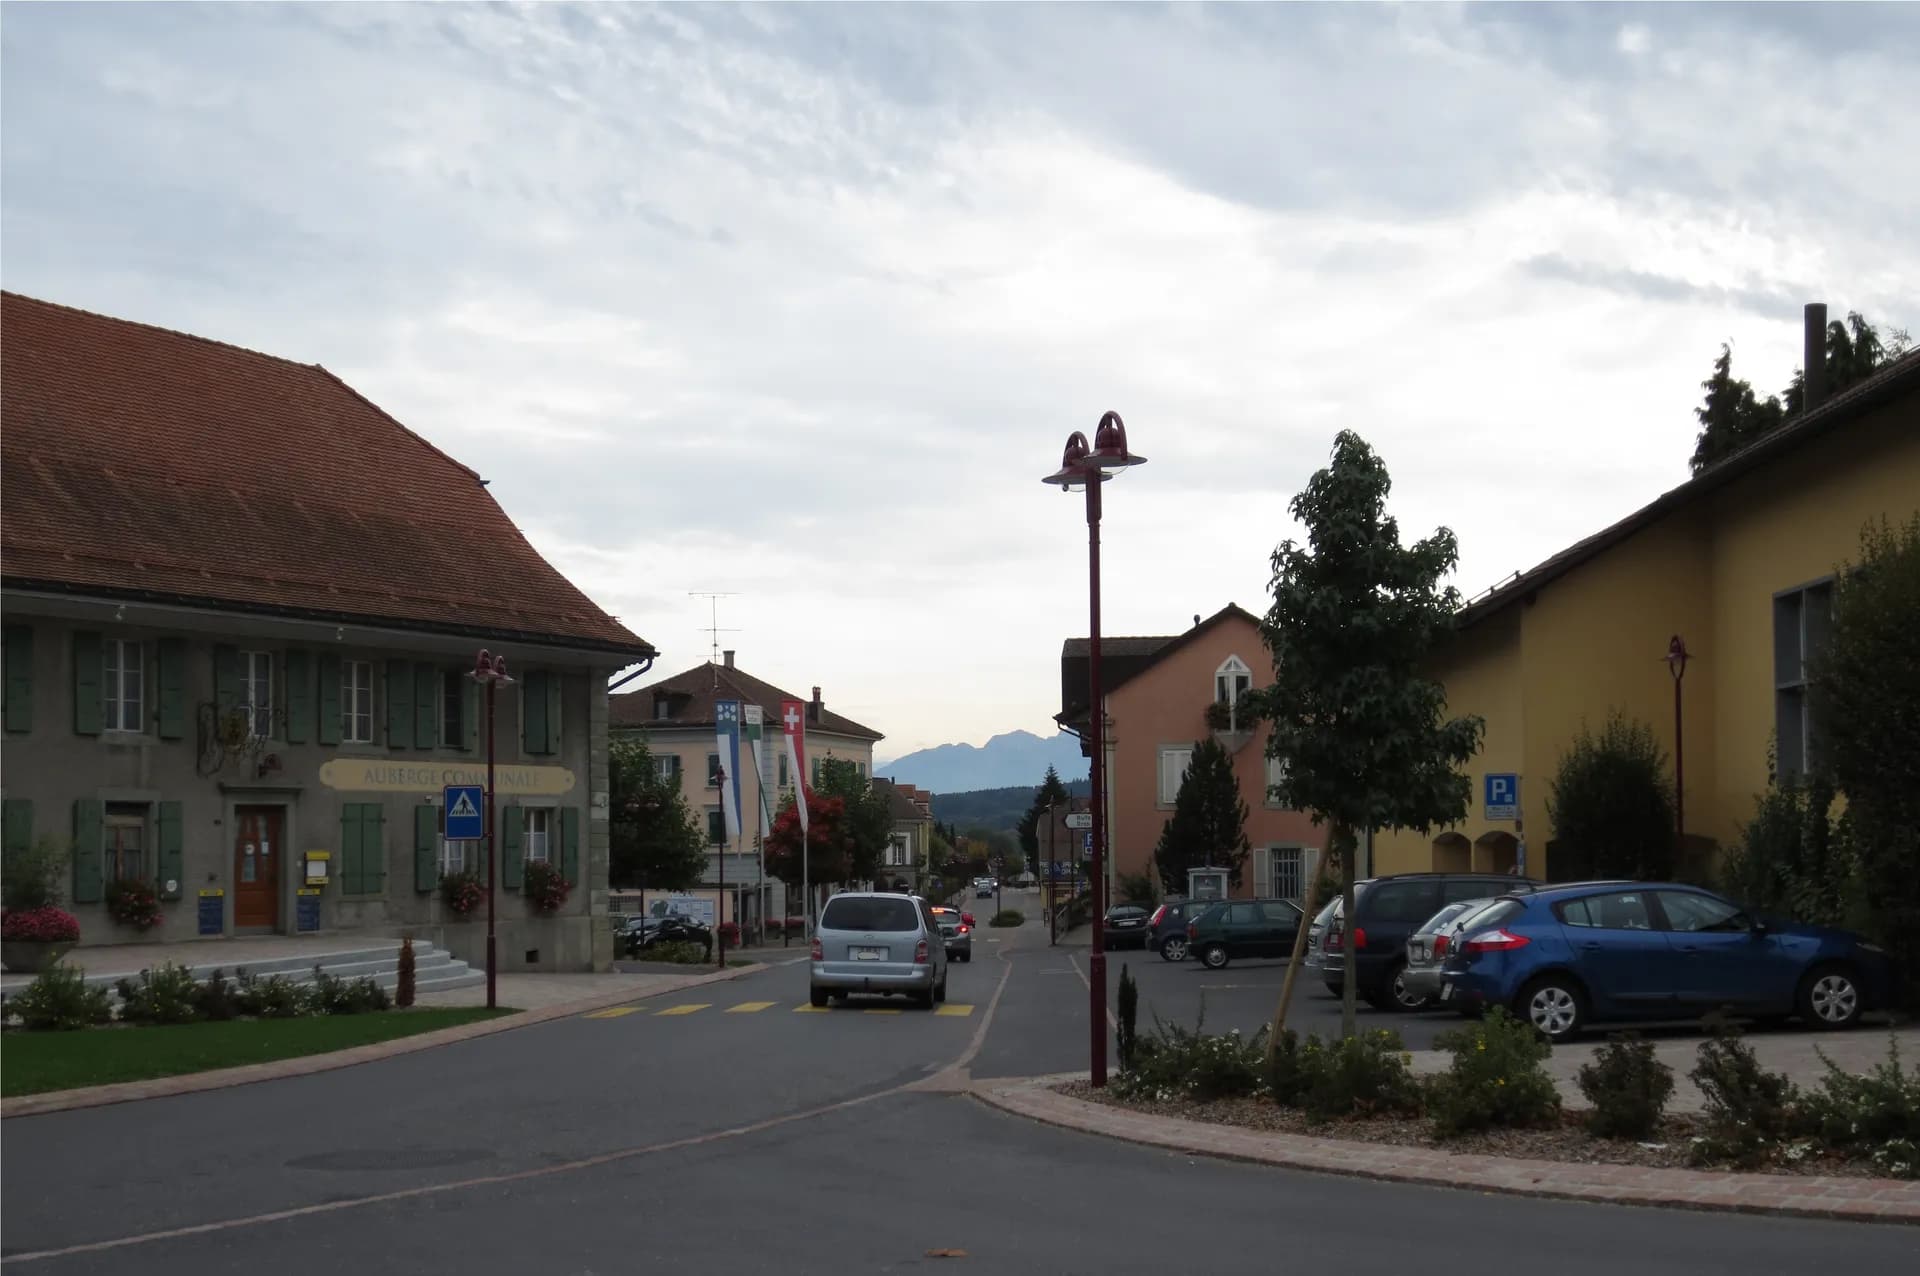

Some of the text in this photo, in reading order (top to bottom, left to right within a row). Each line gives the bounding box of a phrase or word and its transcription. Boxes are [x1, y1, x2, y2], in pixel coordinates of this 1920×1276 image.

[364, 766, 541, 787] AUBERGE COMMUNALE
[1491, 778, 1507, 801] P
